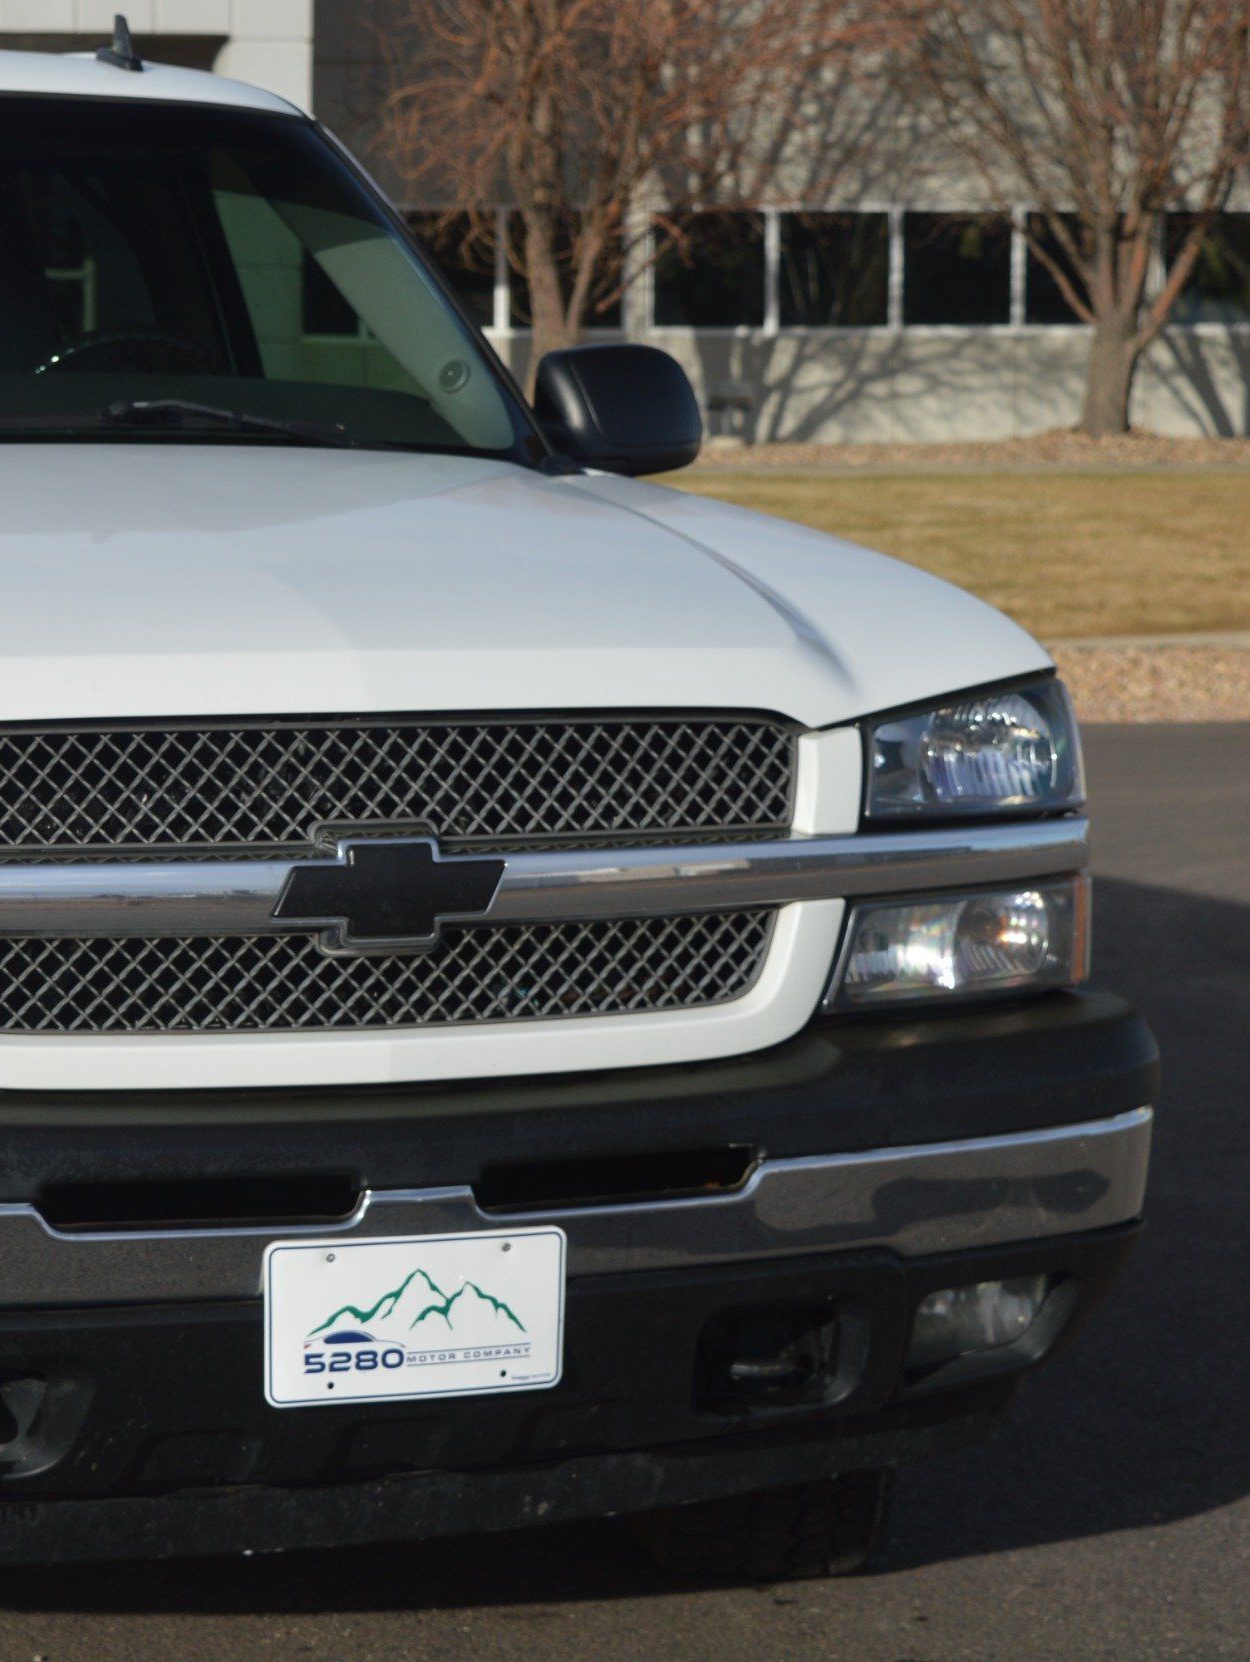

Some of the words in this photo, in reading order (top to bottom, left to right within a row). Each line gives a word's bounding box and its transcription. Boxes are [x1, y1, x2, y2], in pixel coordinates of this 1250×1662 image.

[304, 1348, 404, 1374] 5280
[406, 1353, 456, 1362] MOTOR
[463, 1346, 530, 1359] COMPANY
